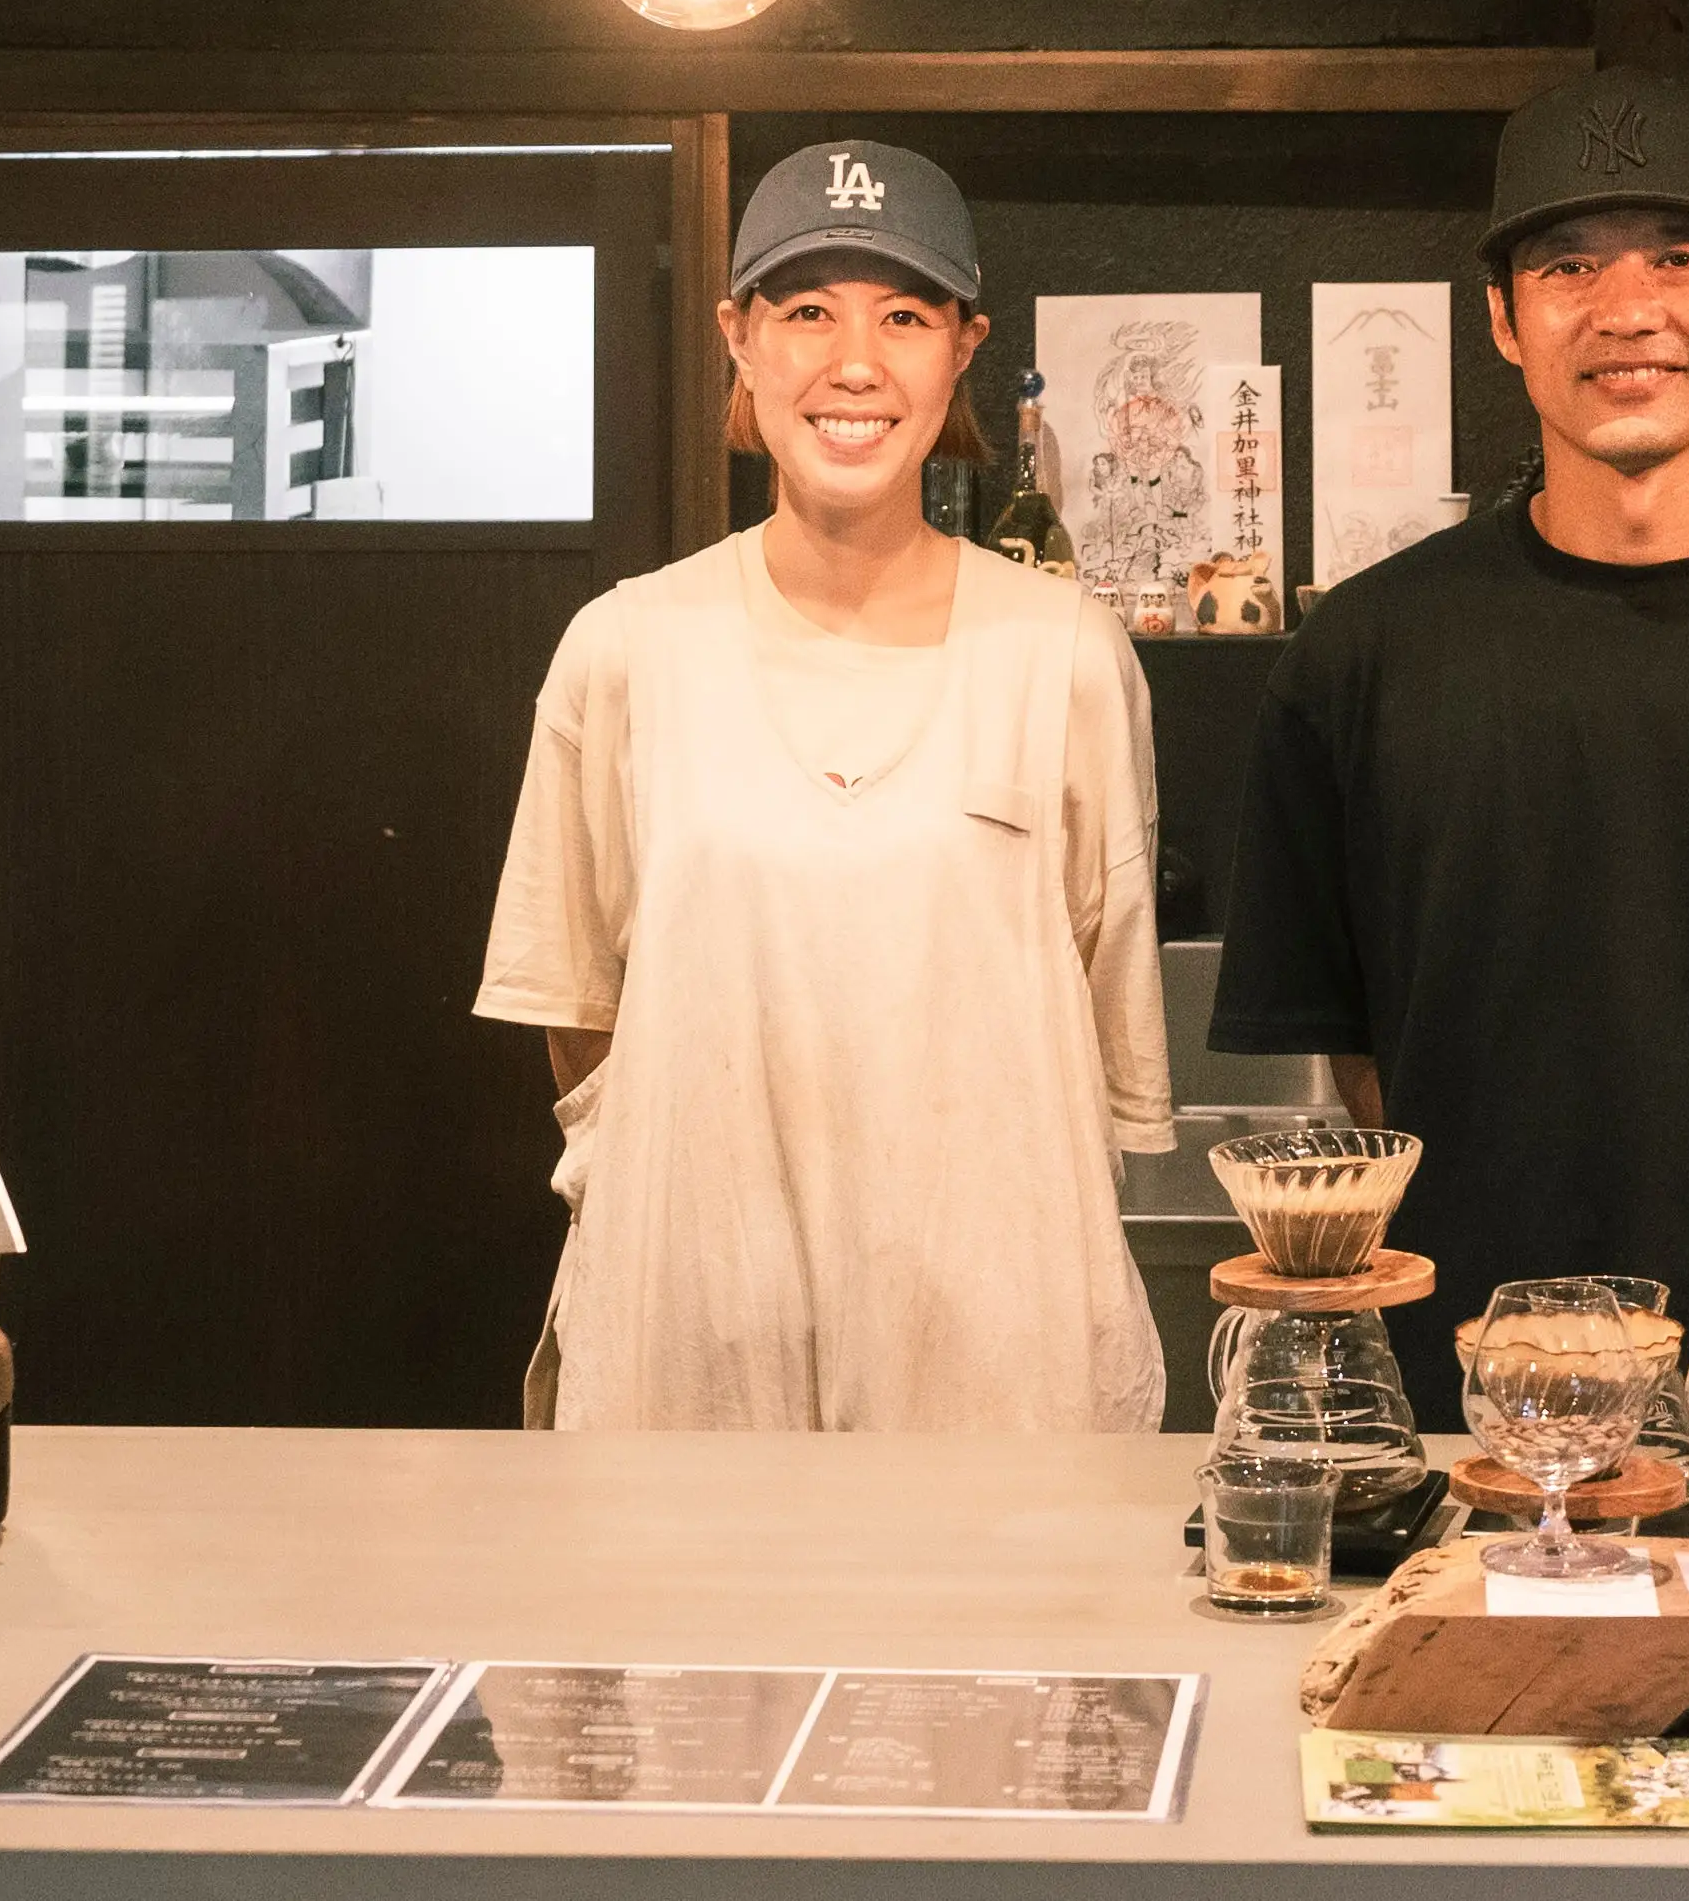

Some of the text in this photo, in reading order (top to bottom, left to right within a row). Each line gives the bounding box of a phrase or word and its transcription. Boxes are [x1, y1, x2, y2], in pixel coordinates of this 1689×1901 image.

[825, 152, 885, 210] LA
[1230, 380, 1263, 561] 金井加里神社神
